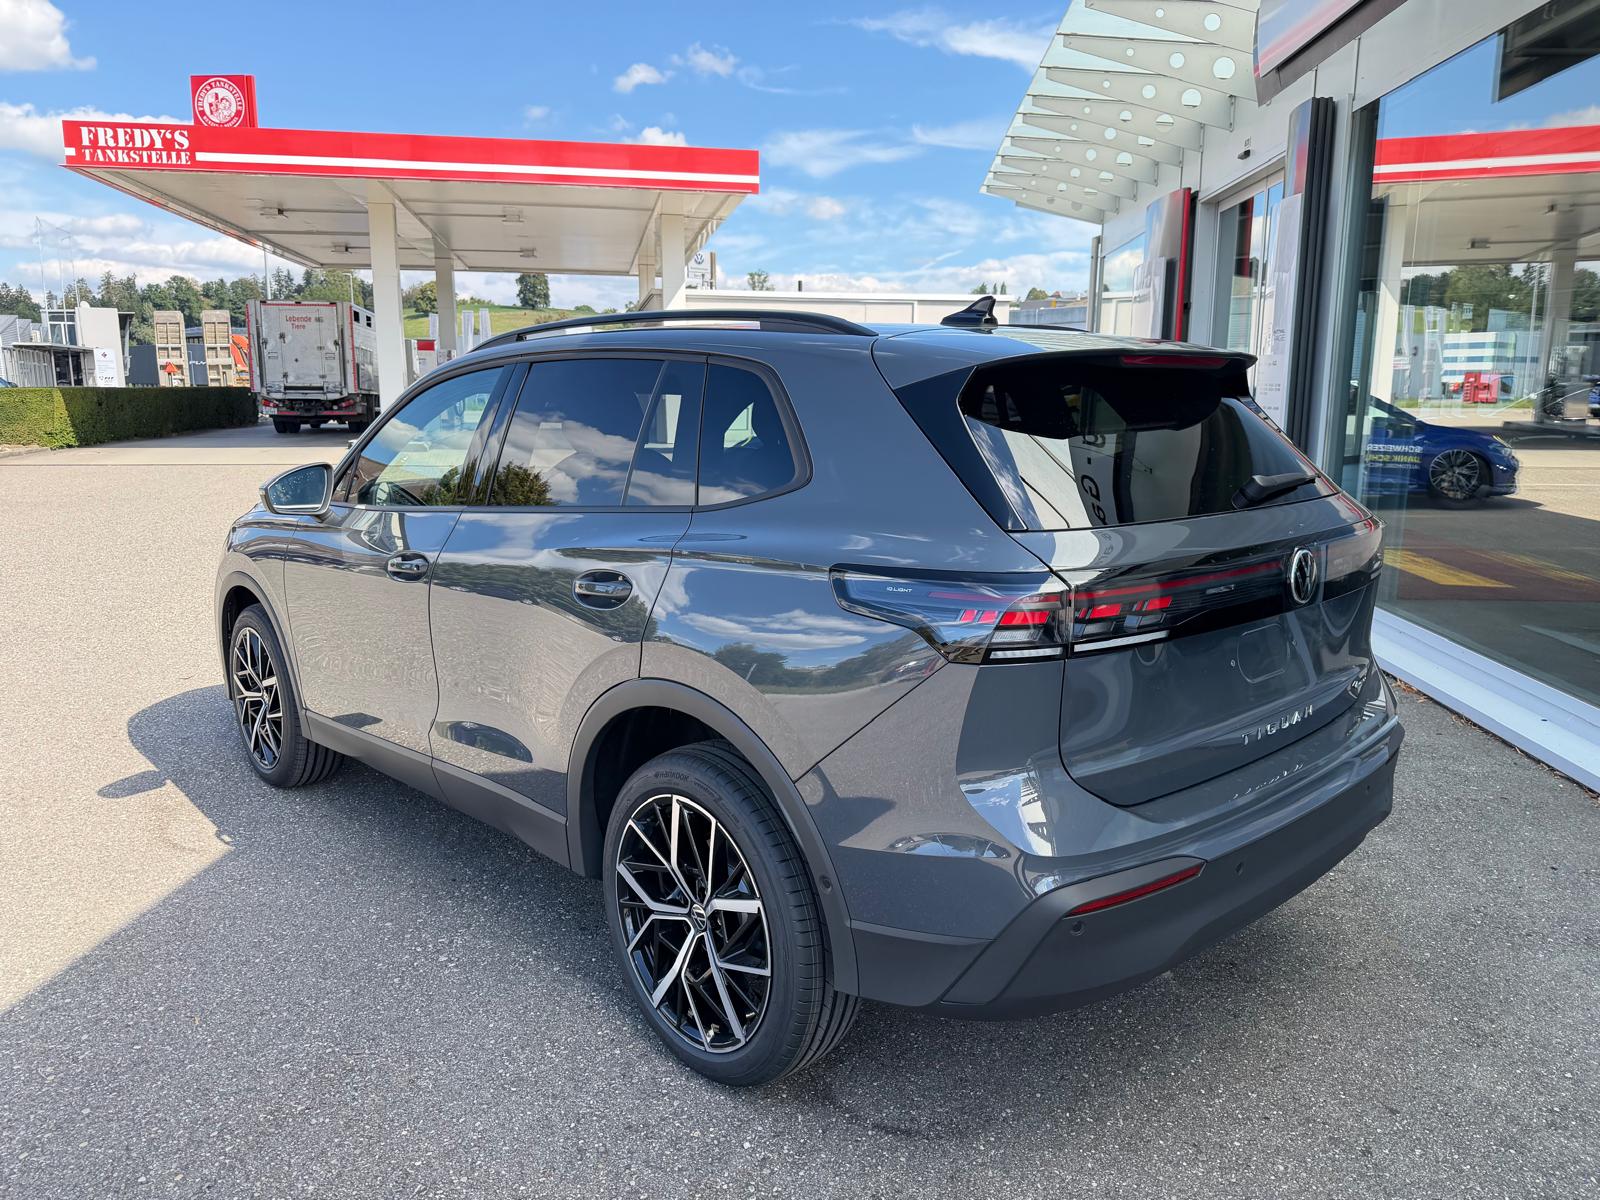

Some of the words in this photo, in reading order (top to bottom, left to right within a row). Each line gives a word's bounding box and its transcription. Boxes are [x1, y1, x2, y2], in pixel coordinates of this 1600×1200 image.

[210, 81, 243, 111] TANKSTELLE
[80, 126, 190, 150] FREDY'S
[82, 148, 191, 165] TANKSTELLE
[285, 314, 312, 323] Lebende
[291, 322, 306, 330] Tiere
[1240, 704, 1315, 746] TIGUAN
